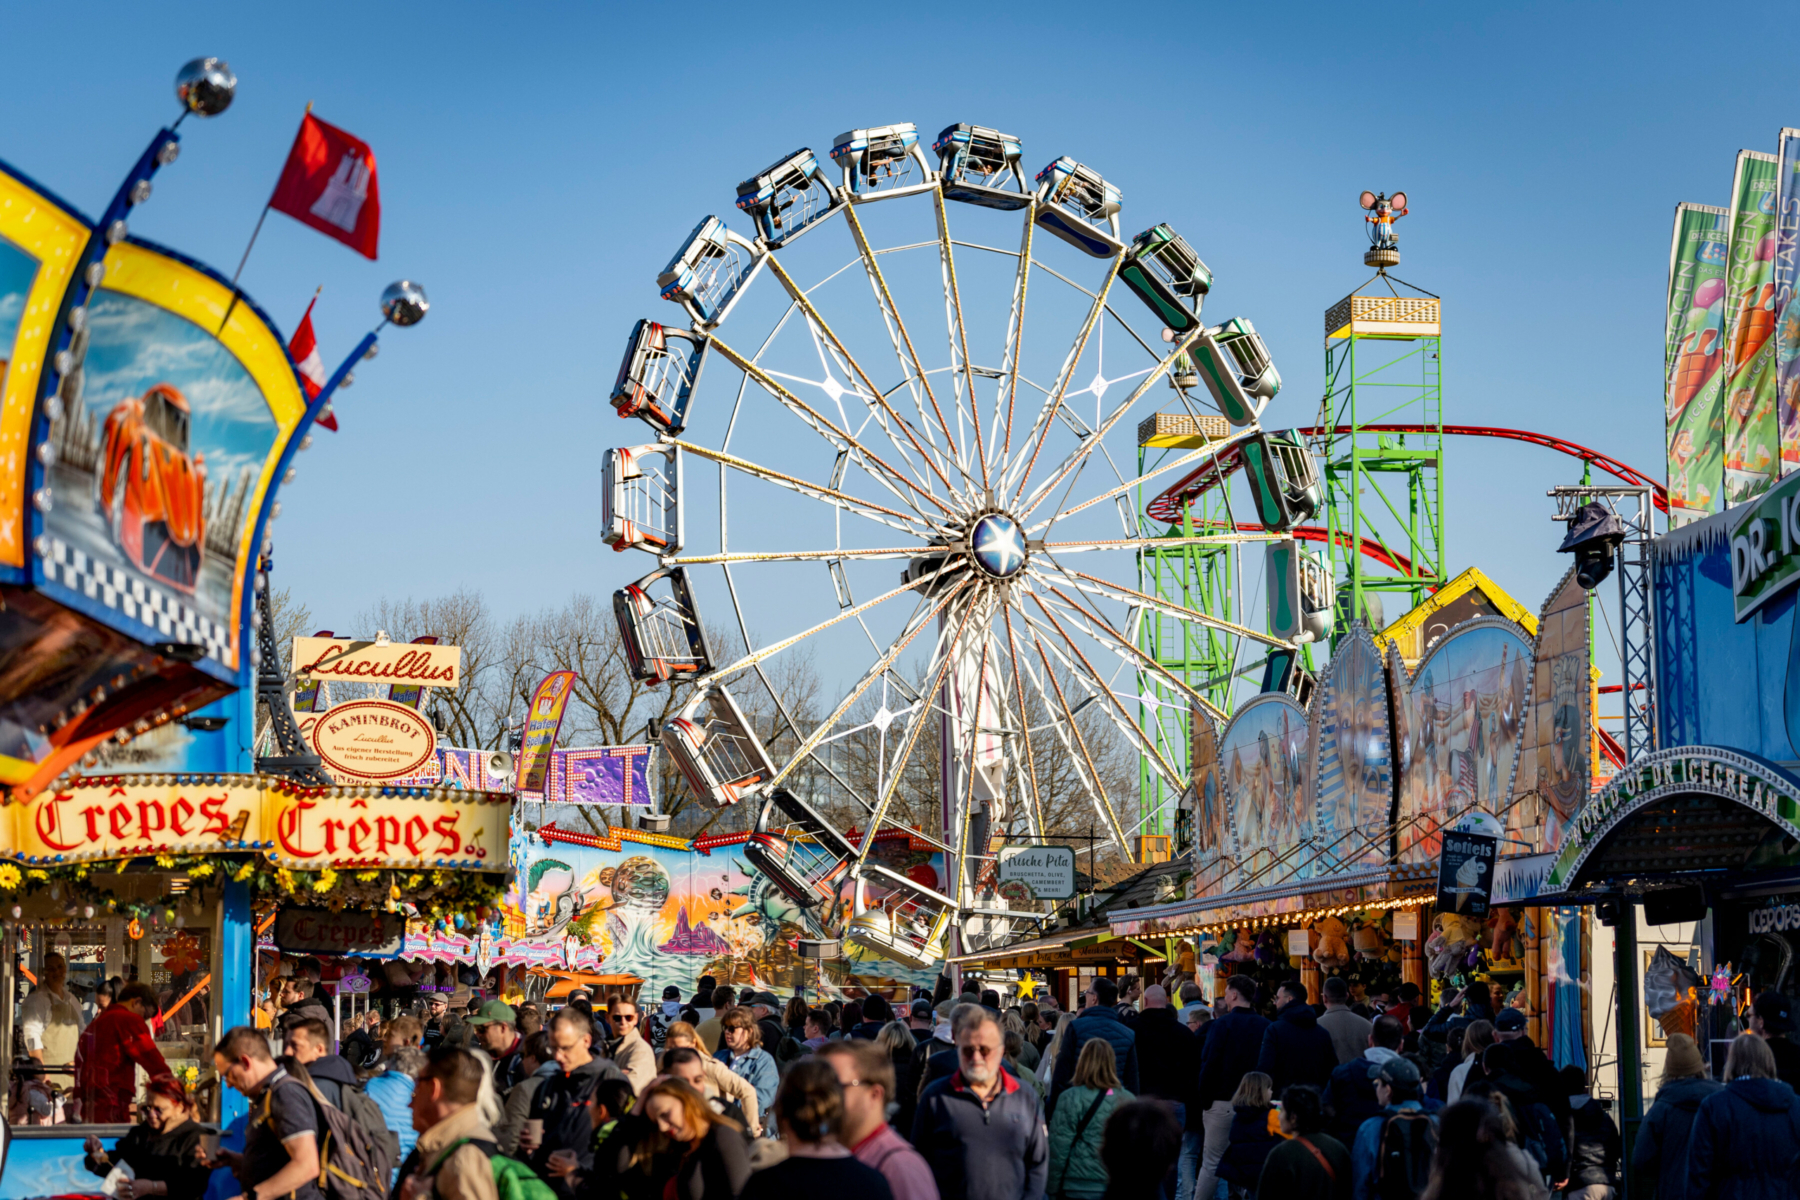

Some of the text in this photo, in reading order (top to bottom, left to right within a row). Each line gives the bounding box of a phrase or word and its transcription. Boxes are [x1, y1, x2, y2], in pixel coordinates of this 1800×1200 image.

[1776, 196, 1800, 302] SHAKES
[1733, 518, 1774, 597] DR.
[301, 644, 454, 681] Lucullus
[393, 690, 417, 703] Hafen
[328, 714, 421, 739] KAMINBROT
[529, 718, 557, 731] Hafen
[365, 755, 400, 763] zubereitet
[374, 748, 413, 757] Herstellung
[1570, 757, 1779, 848] WORLD OF DR ICECREAM
[35, 787, 229, 851] Crêpes
[278, 799, 461, 857] Crêpes
[1004, 852, 1070, 868] Frische Pita
[294, 915, 386, 948] Crêpes
[1749, 905, 1800, 934] ICEPOPS
